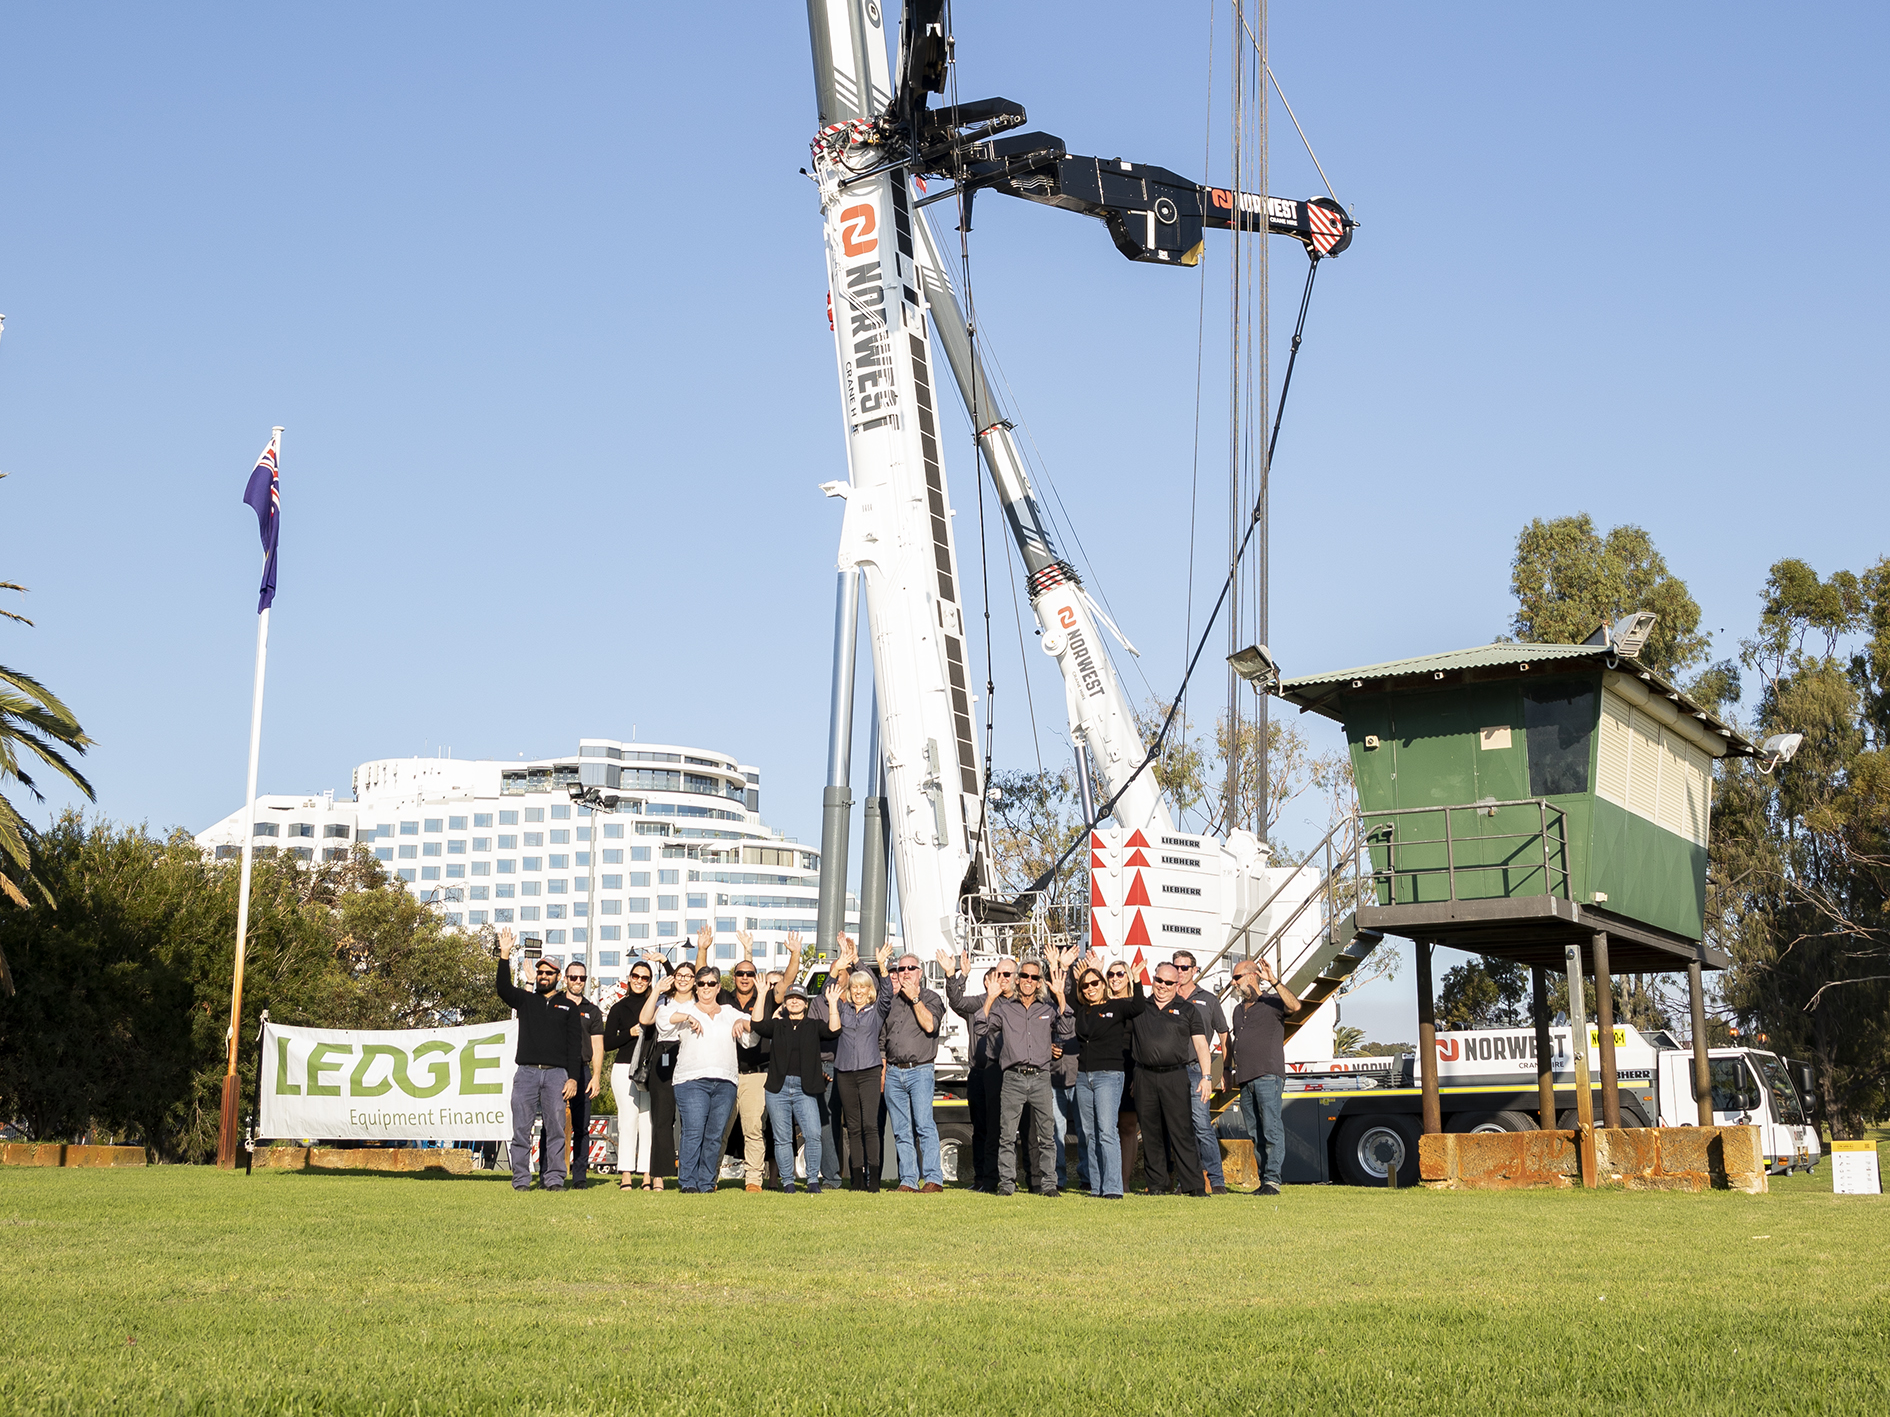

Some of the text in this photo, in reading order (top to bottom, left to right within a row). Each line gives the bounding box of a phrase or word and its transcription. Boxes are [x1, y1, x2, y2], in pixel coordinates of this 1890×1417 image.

[1234, 192, 1297, 219] NORWEST
[846, 261, 900, 432] NORWEST
[845, 361, 856, 405] CRANE
[1067, 628, 1105, 697] NORWEST
[1161, 836, 1200, 849] LIEBHERR
[1161, 855, 1200, 868] LIEBHERR
[1162, 884, 1201, 896] LIEBHERR
[1162, 923, 1201, 936] LIEBHERR
[276, 1033, 505, 1098] LEDGE
[1600, 1070, 1651, 1079] BHERR
[350, 1108, 504, 1130] Equipment Finance
